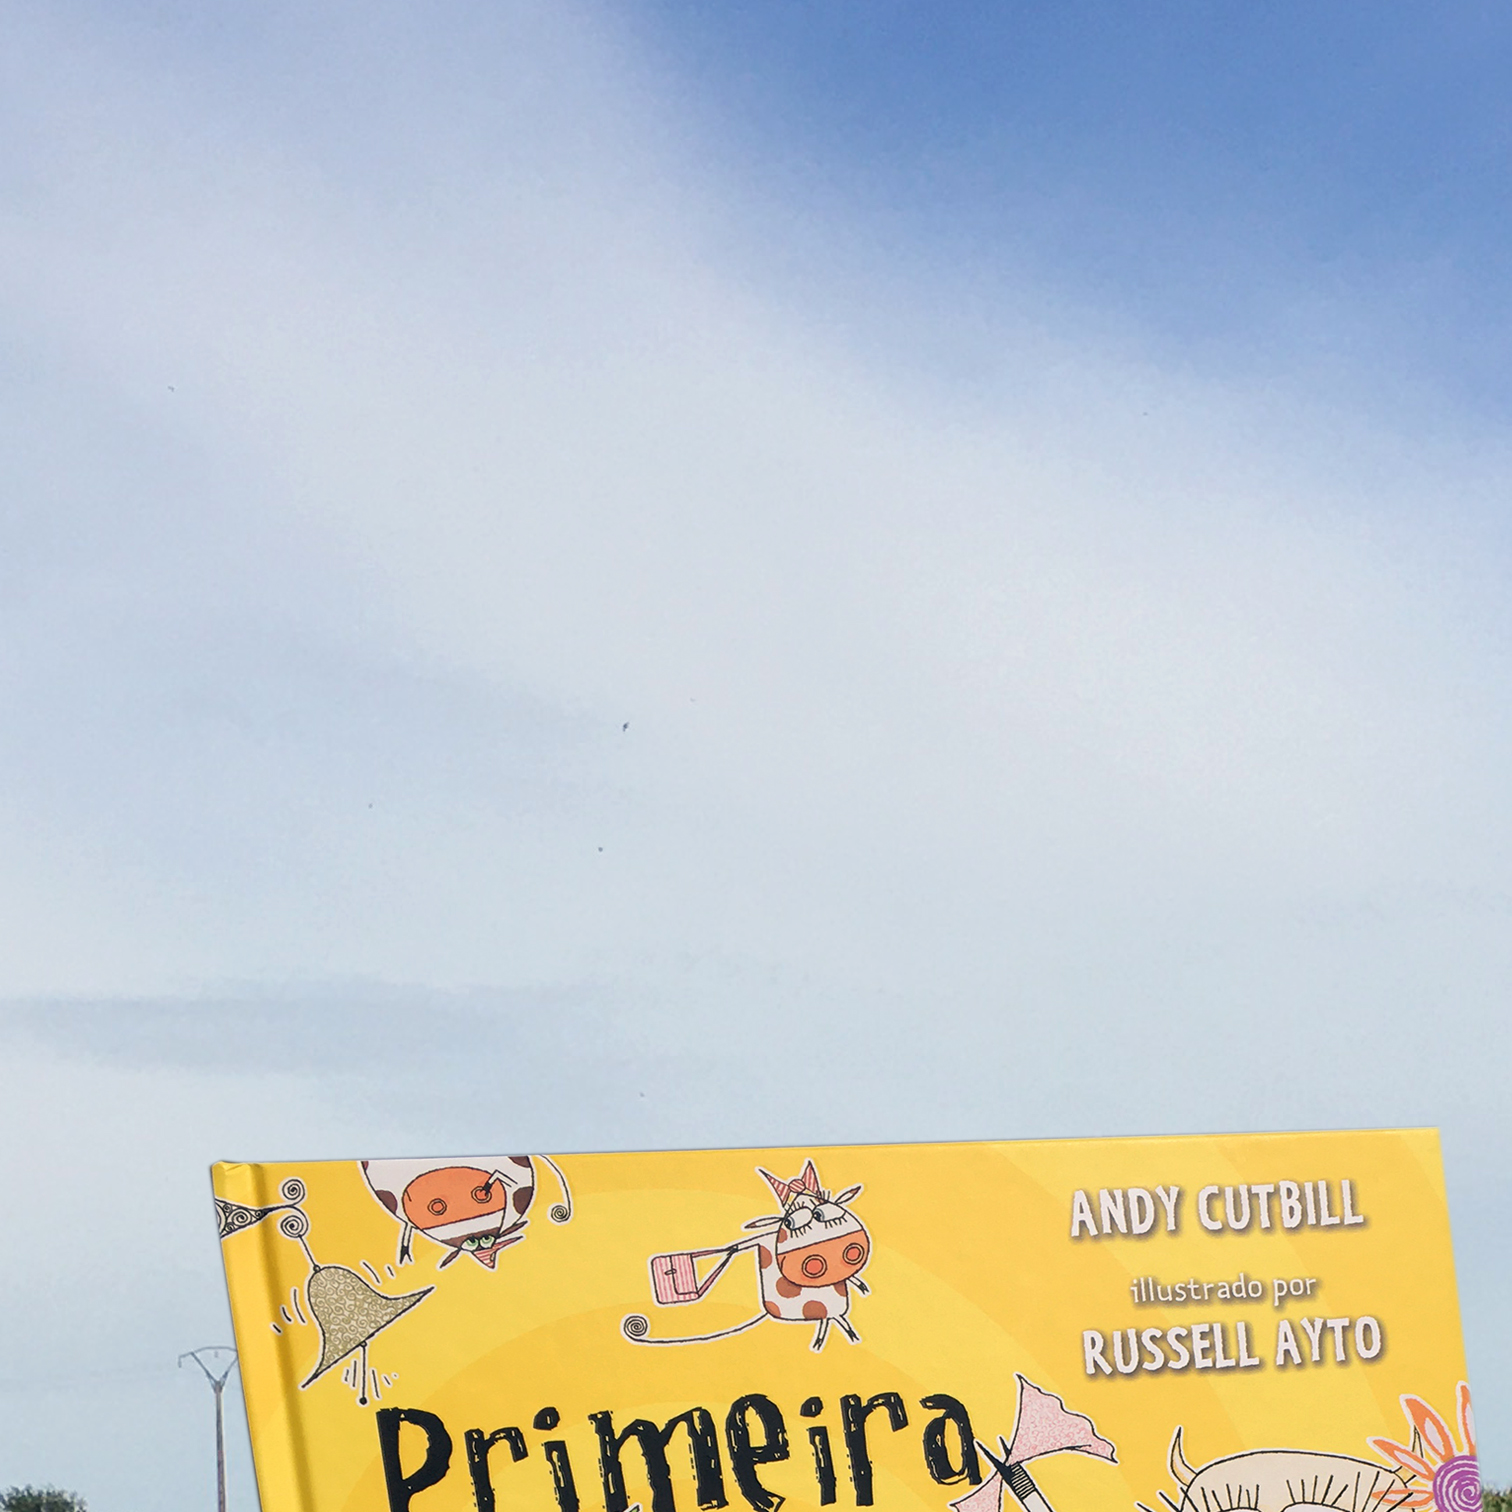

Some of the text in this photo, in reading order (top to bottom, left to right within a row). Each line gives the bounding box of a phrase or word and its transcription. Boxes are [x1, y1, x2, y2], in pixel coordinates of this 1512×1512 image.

[1071, 1179, 1364, 1237] ANDY CUTBILL
[1130, 1273, 1317, 1307] illustrado por
[1083, 1316, 1382, 1375] RUSSELL AYTO
